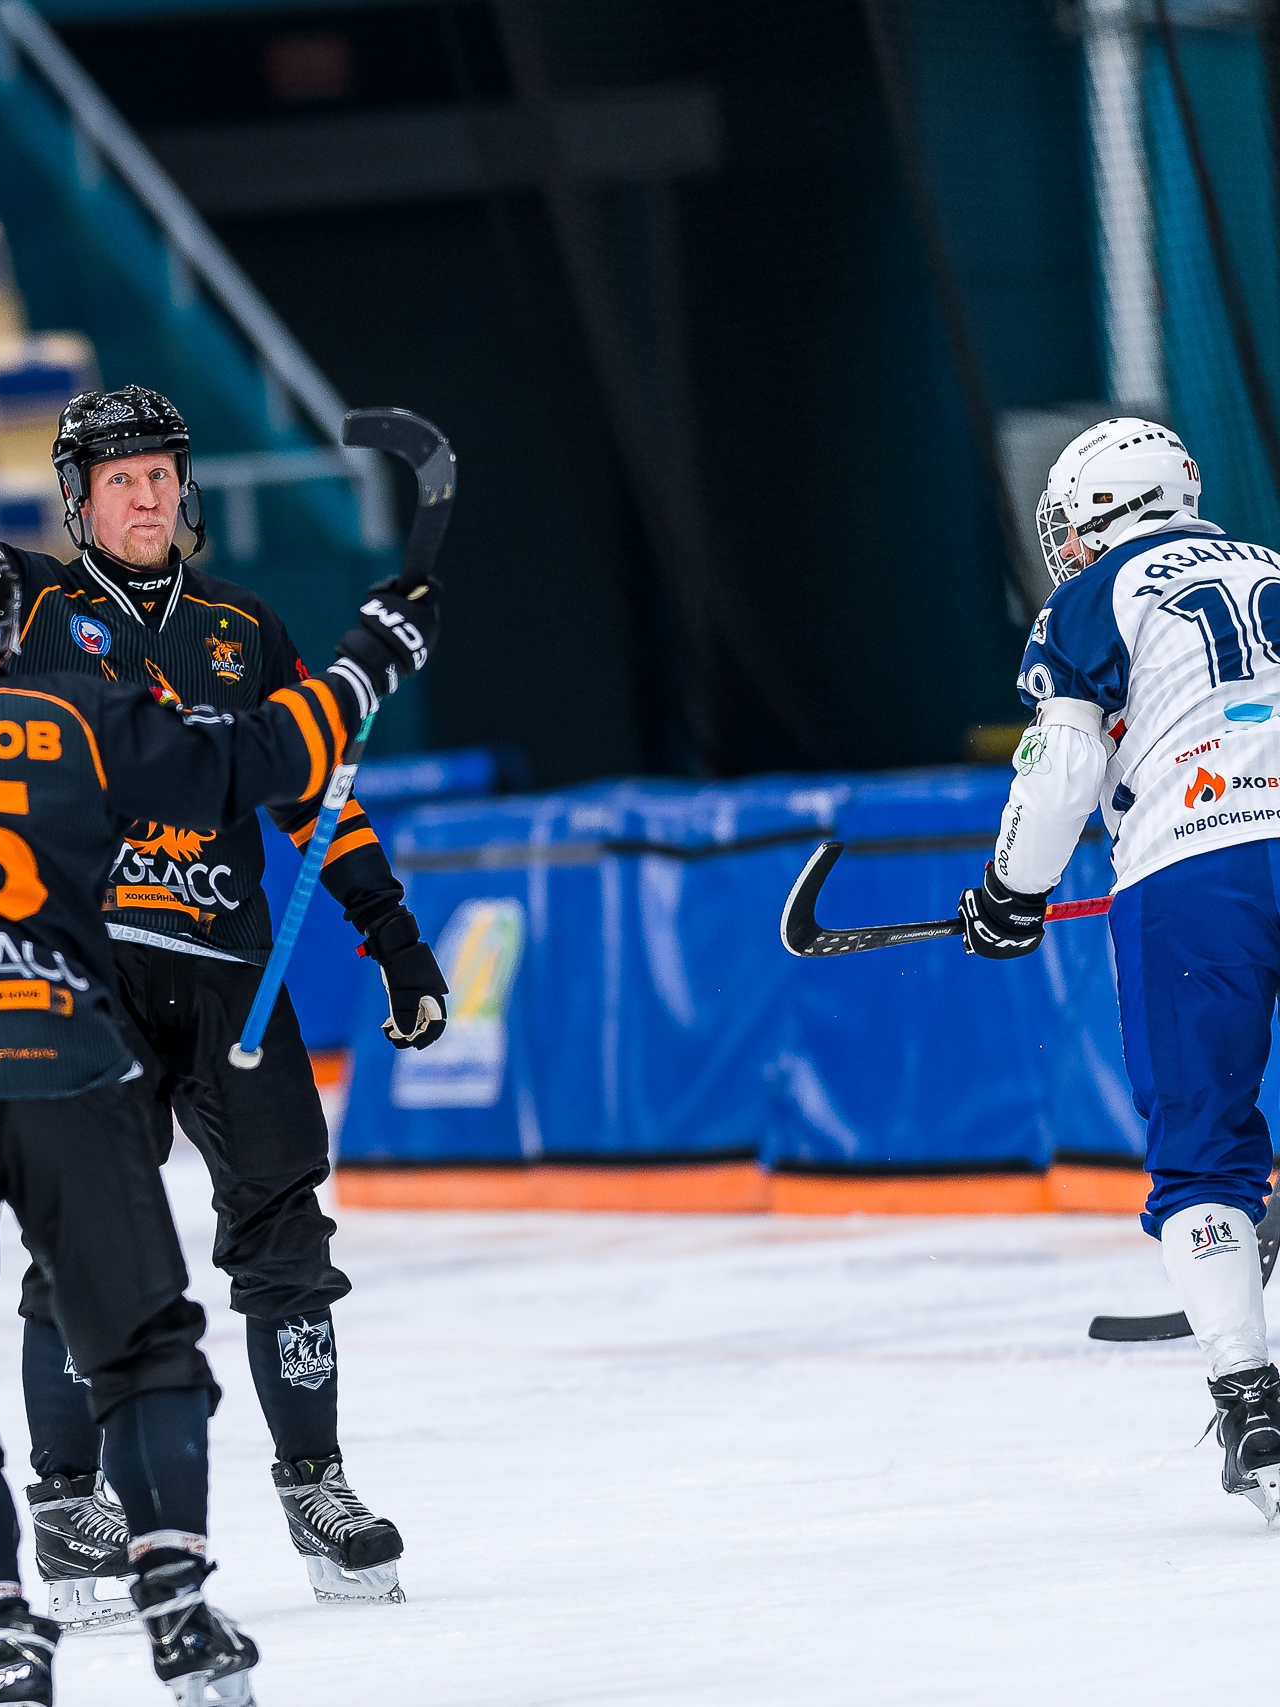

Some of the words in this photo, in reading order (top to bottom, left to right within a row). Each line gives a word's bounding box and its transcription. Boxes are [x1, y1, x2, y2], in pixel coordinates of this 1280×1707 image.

[1078, 433, 1109, 456] Reebok
[1182, 459, 1200, 482] 10
[1081, 518, 1104, 533] JOFA
[127, 576, 173, 592] CCM
[211, 659, 245, 677] КУЗБАСС
[1231, 776, 1280, 789] ЭХОВ
[124, 891, 181, 903] ХОККЕЙНЫ
[282, 1353, 335, 1378] КУЗБАСС
[68, 1540, 109, 1560] CCM
